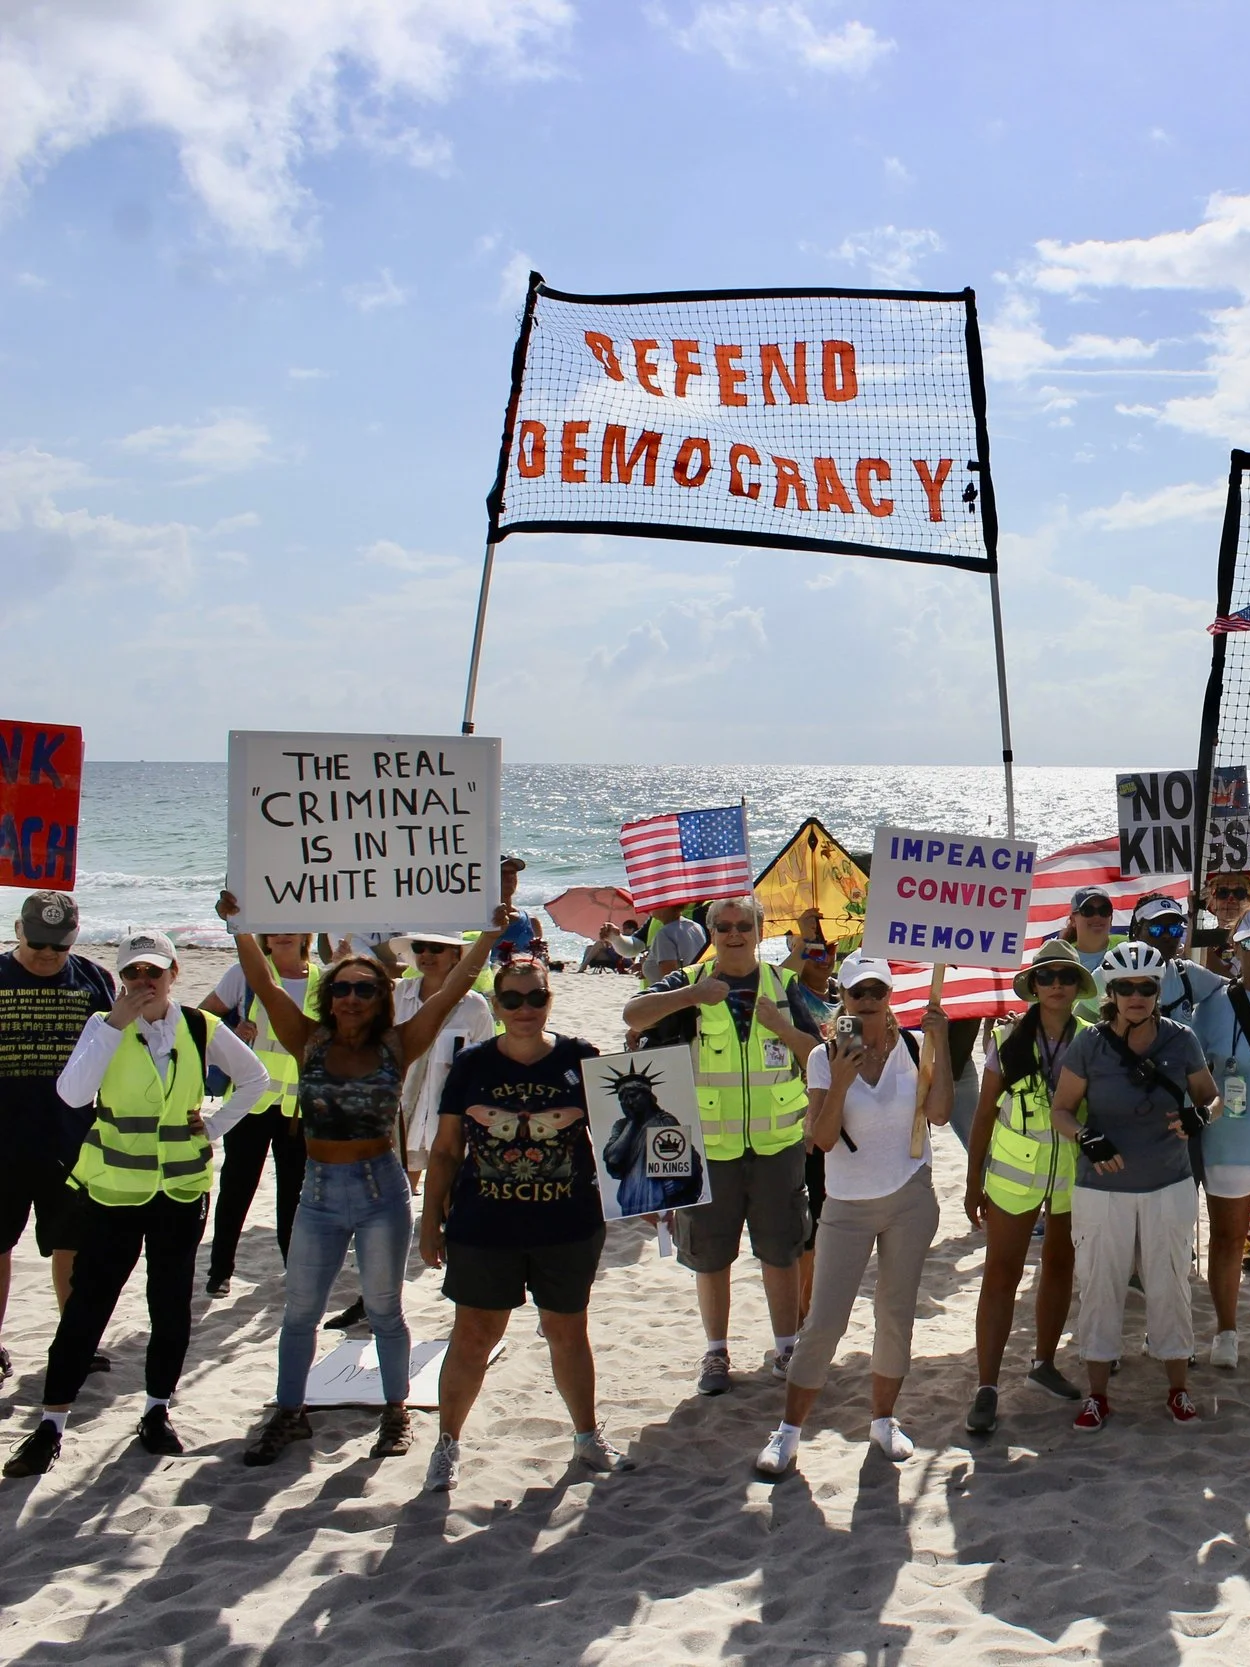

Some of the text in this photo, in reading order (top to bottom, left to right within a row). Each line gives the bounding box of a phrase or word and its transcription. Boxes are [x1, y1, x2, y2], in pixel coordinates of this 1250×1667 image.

[584, 330, 858, 407] DEFEND
[518, 420, 952, 522] DEMOCRACY
[282, 750, 455, 782] THE REAL
[252, 782, 476, 828] "CRIMINAL"
[1131, 771, 1193, 822] NO
[301, 824, 468, 864] IS IN THE
[890, 837, 1034, 874] IMPEACH
[264, 862, 482, 904] WHITE HOUSE
[897, 876, 1027, 910] CONVICT
[888, 921, 1018, 955] REMOVE
[16, 988, 39, 996] ABOUT
[41, 988, 56, 996] OUR
[492, 1082, 562, 1099] RESIST
[648, 1161, 690, 1174] NO KINGS
[478, 1178, 573, 1201] FASCISM
